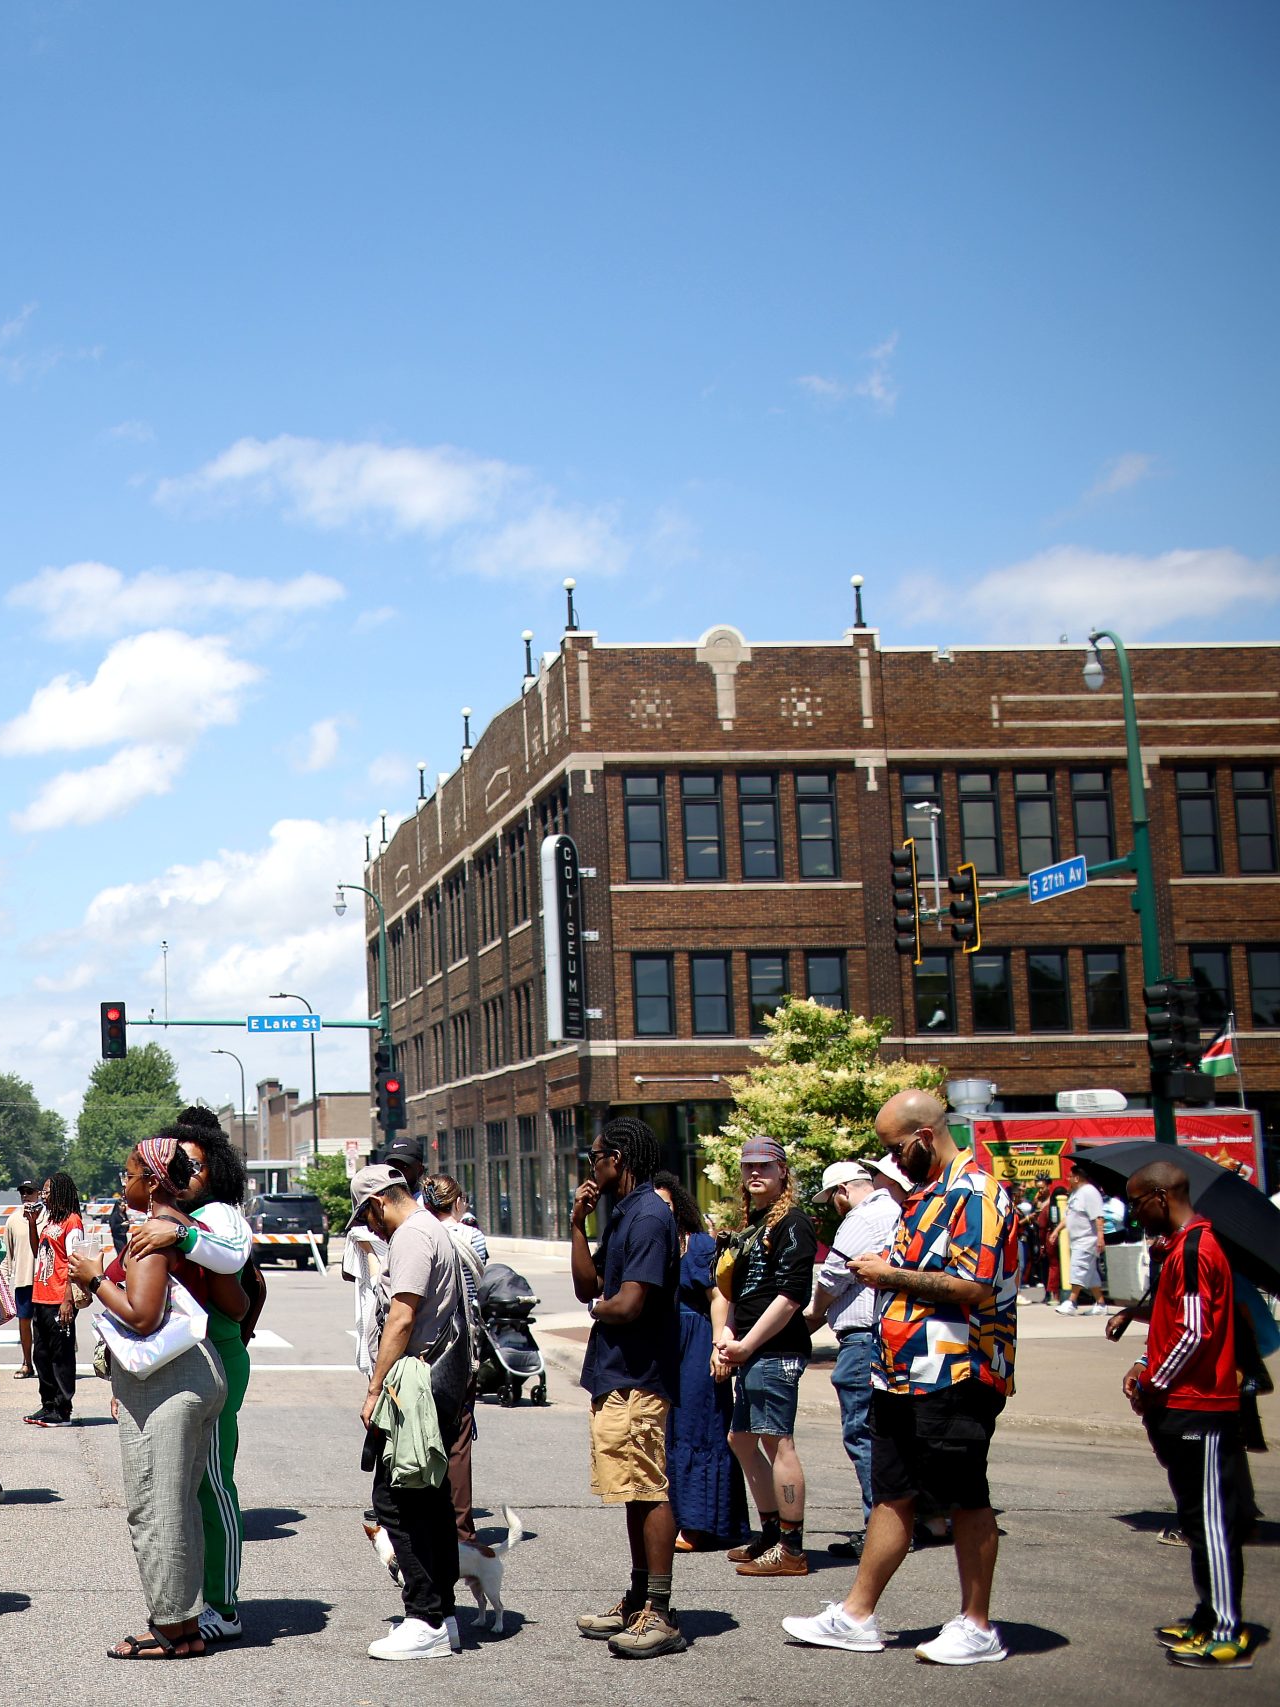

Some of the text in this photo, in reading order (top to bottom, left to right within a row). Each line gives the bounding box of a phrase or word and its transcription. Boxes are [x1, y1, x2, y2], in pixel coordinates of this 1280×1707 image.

[1032, 867, 1082, 896] S 27th Av
[563, 846, 578, 993] COLISEUM
[252, 1018, 317, 1029] E Lake St
